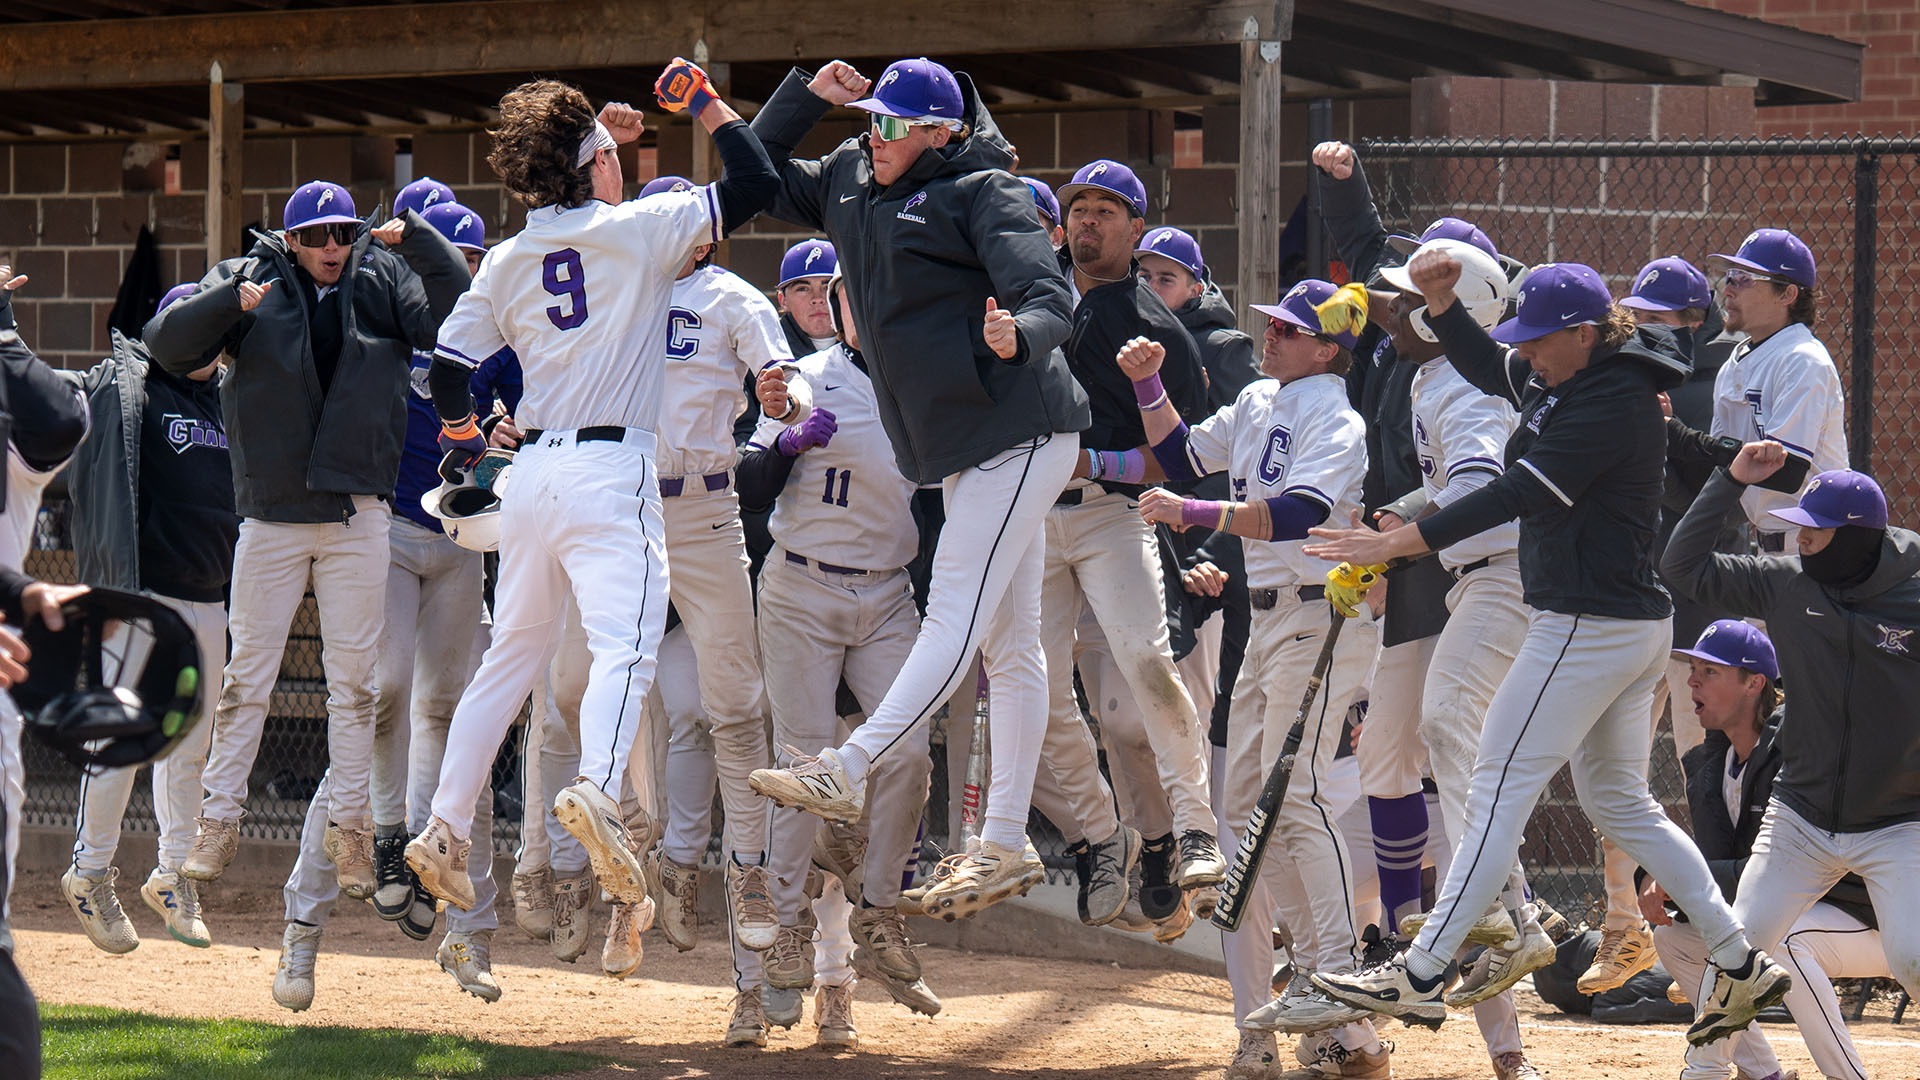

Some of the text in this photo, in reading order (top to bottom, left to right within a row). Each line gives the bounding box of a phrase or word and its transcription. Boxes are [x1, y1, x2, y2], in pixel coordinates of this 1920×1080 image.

[542, 247, 589, 332] 9
[666, 305, 702, 361] C
[1256, 423, 1292, 487] C
[821, 466, 852, 509] 11
[1213, 803, 1269, 926] marucci
